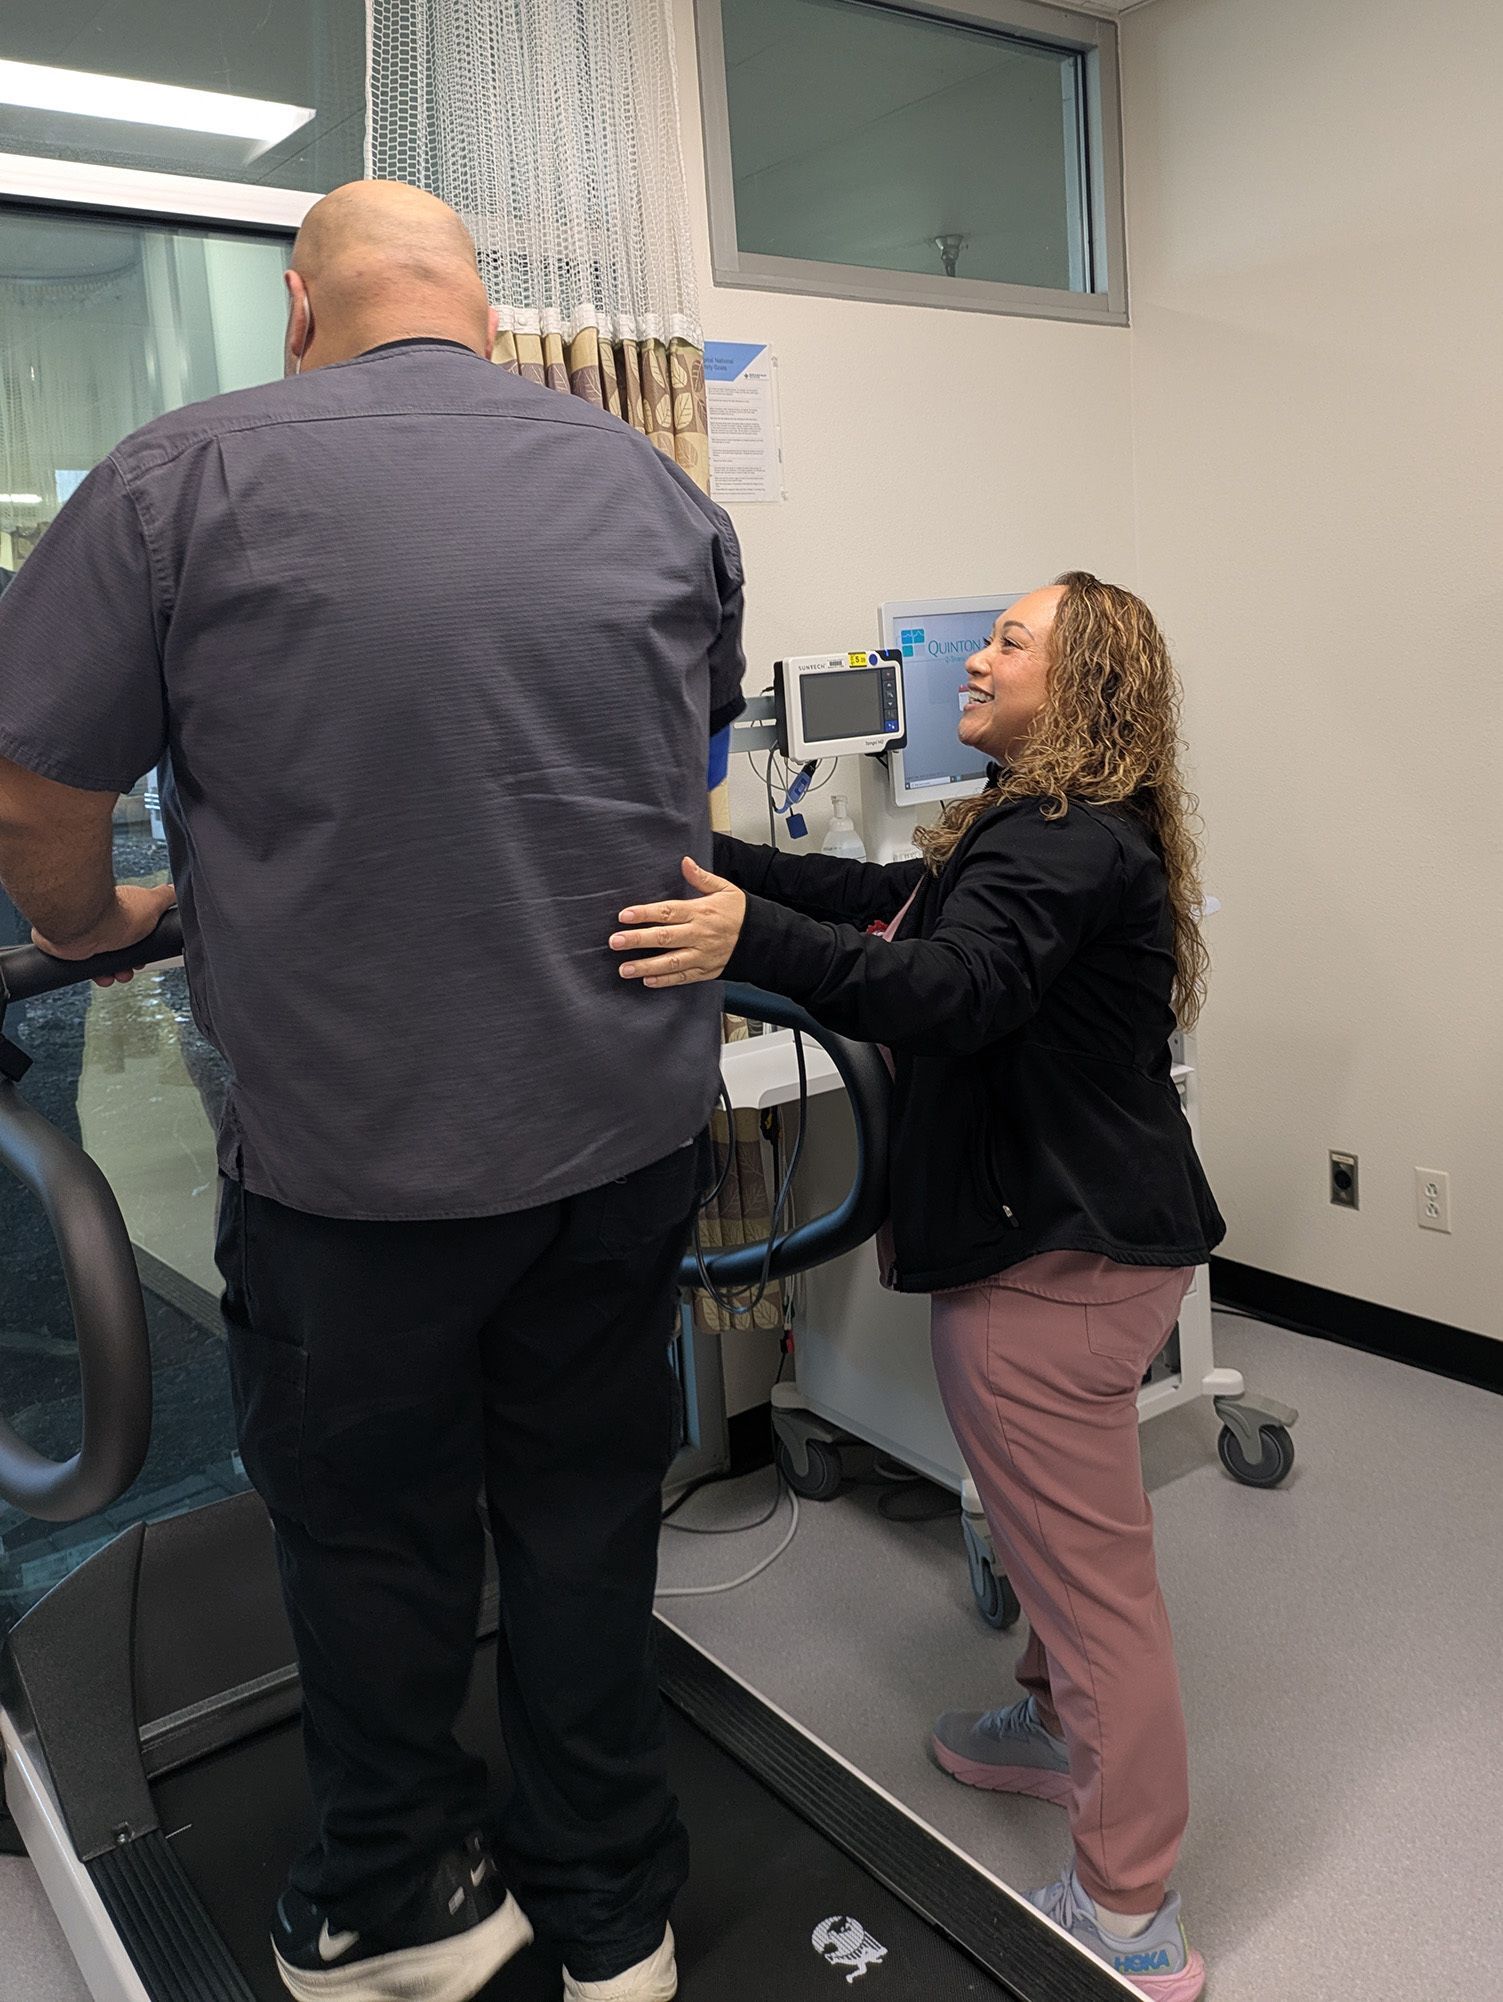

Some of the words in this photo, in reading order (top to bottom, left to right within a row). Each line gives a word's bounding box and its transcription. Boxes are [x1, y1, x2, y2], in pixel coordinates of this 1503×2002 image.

[928, 640, 980, 657] QUINTON
[798, 662, 824, 671] SUNTECH
[1114, 1949, 1170, 1972] HOKA
